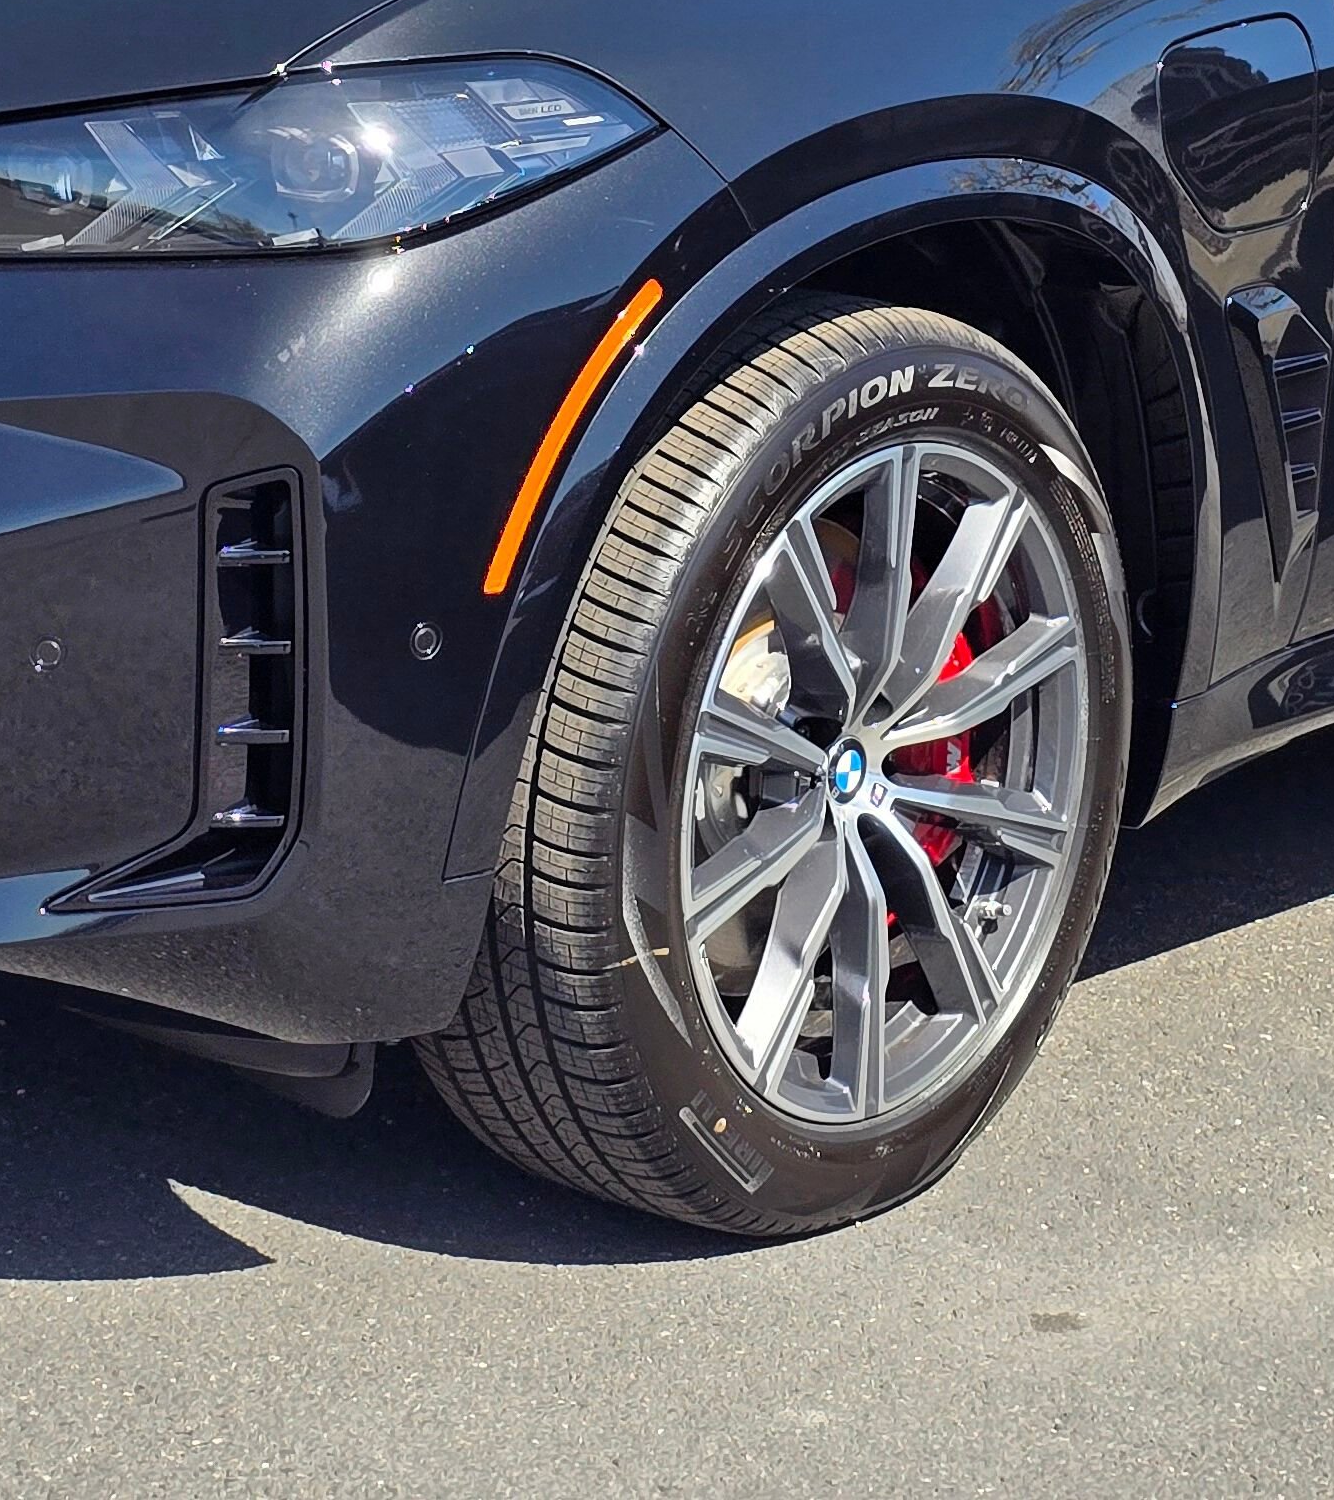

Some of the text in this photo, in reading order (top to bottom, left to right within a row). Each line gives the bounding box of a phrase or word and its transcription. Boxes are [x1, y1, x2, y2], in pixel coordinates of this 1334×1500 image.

[722, 365, 916, 572] SCORPION
[927, 362, 1028, 411] ZERO
[680, 1088, 775, 1194] PIRELI
